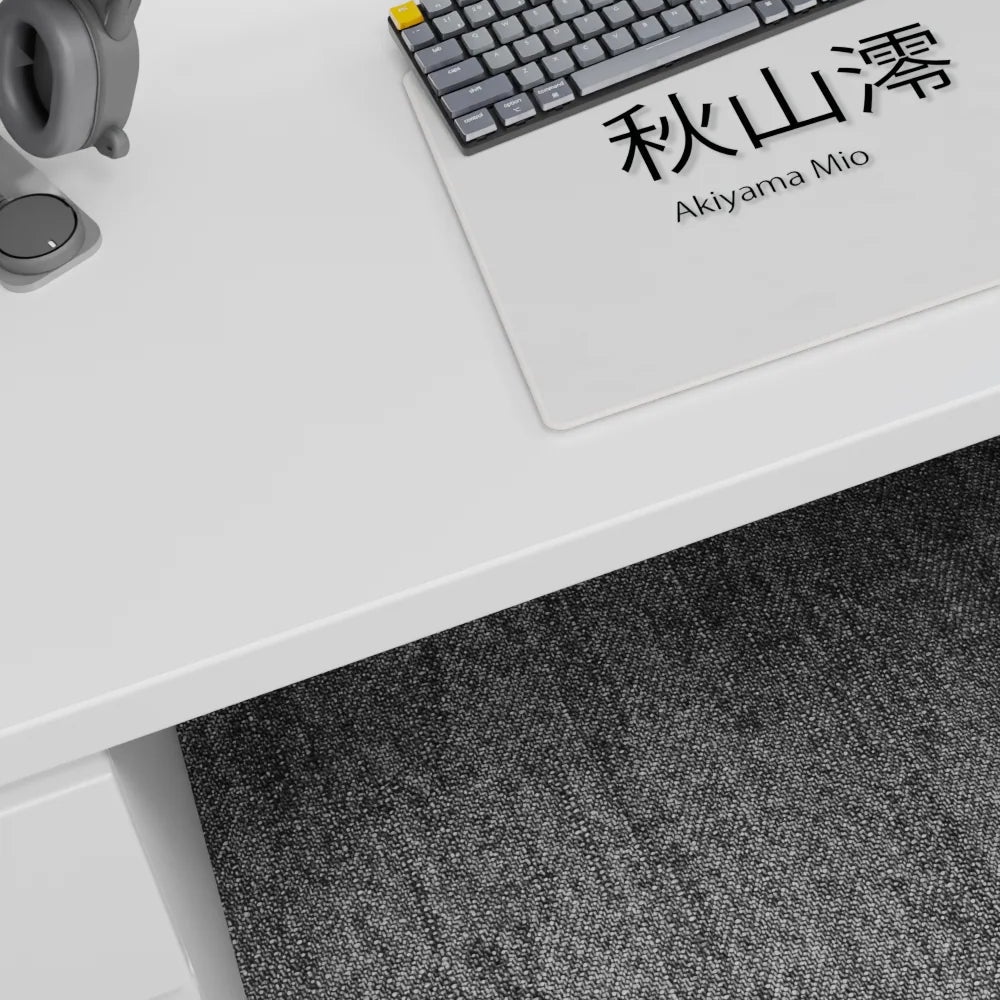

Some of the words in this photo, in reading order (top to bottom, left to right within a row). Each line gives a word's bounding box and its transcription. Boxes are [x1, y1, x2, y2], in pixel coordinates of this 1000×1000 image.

[537, 80, 564, 94] command
[503, 97, 522, 108] option
[602, 22, 952, 182] 秋山澪
[463, 112, 484, 123] control
[675, 170, 806, 223] Akiyama
[810, 151, 870, 179] Mio
